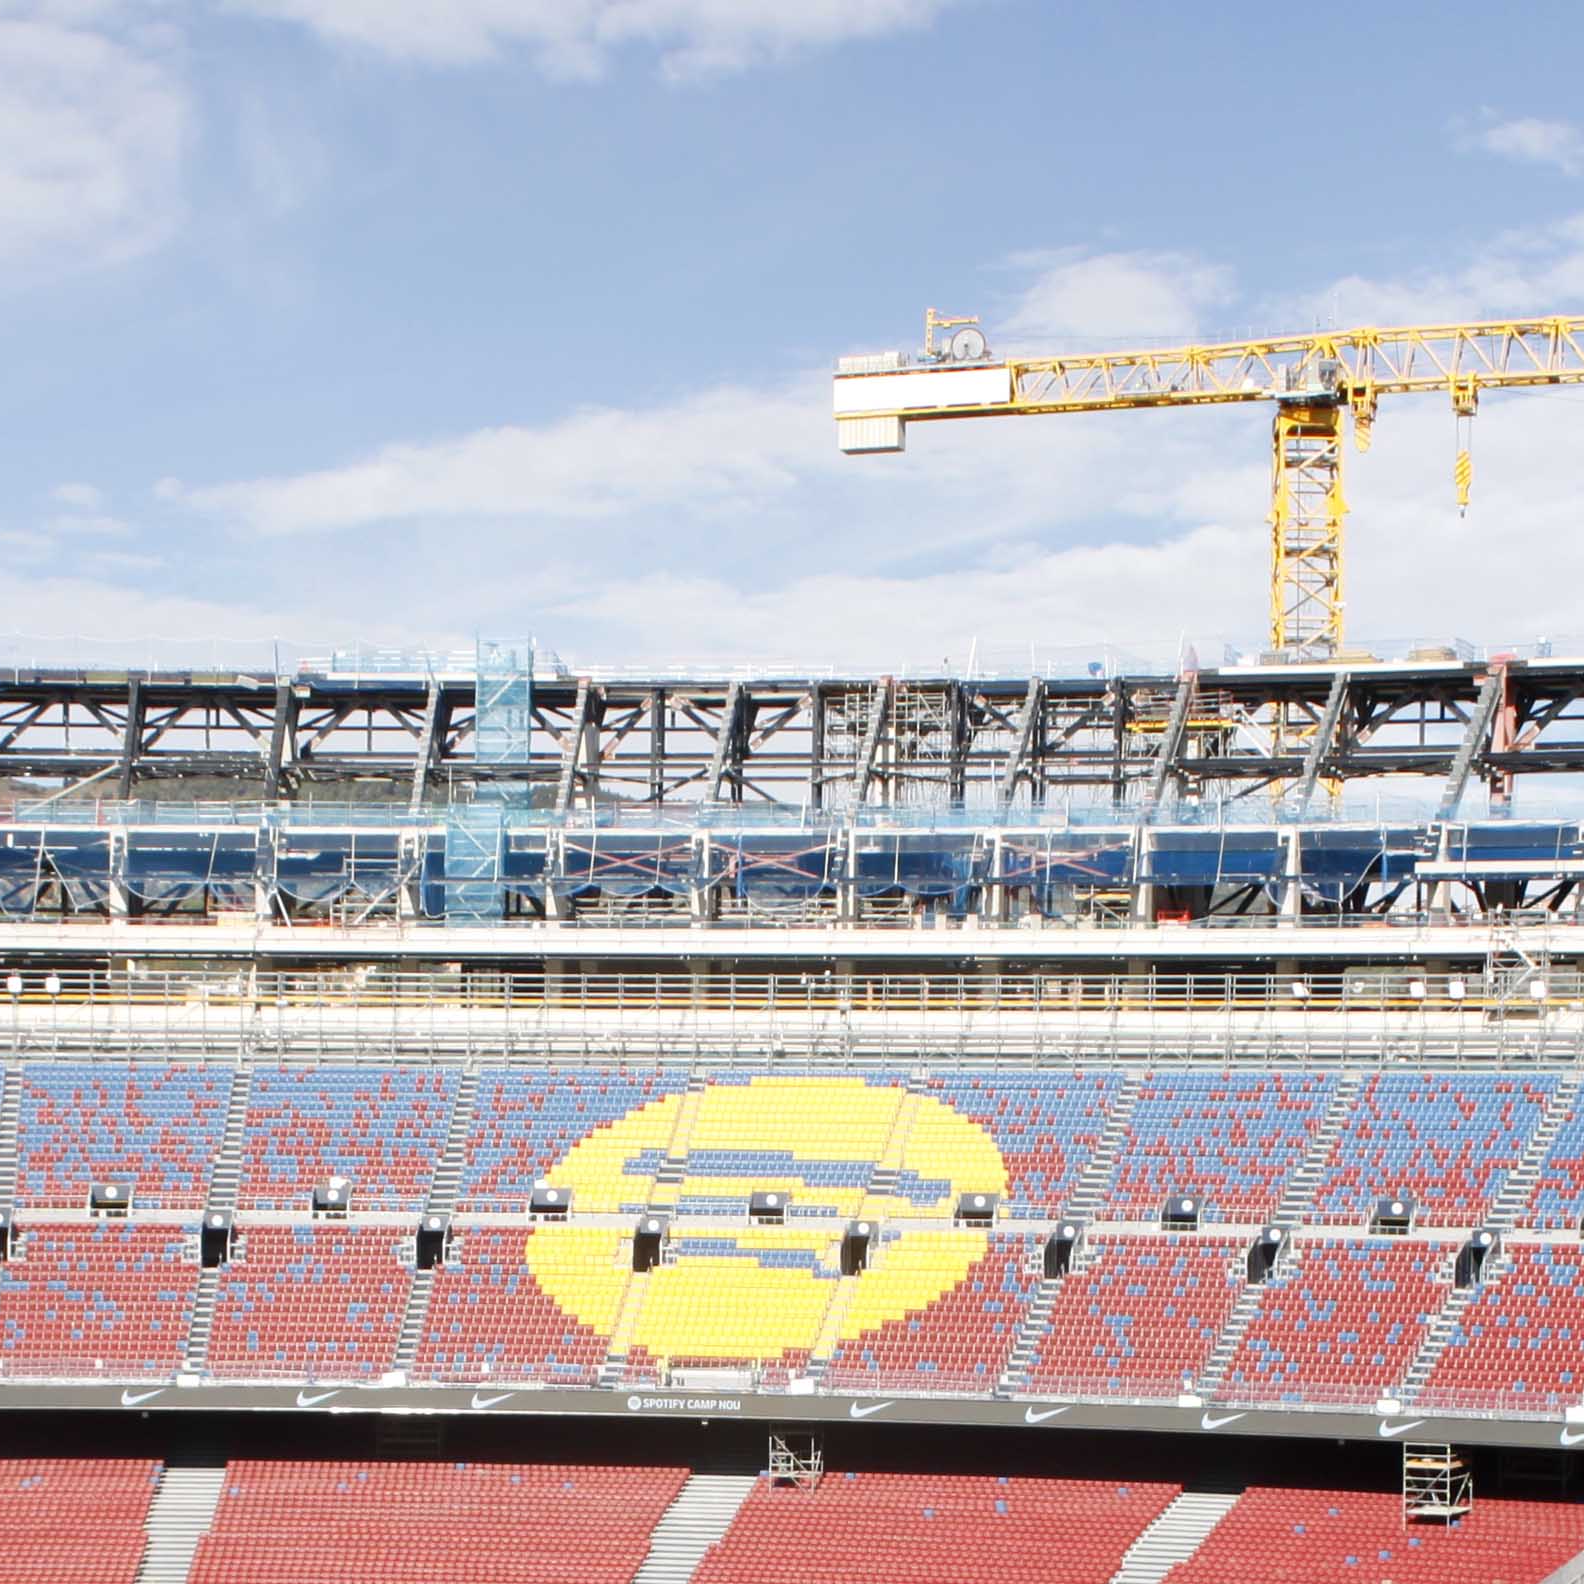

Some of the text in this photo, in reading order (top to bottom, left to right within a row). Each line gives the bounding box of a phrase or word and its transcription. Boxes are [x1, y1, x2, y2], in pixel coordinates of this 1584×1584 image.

[643, 1398, 741, 1410] SPOTIFY CAMP NOU
